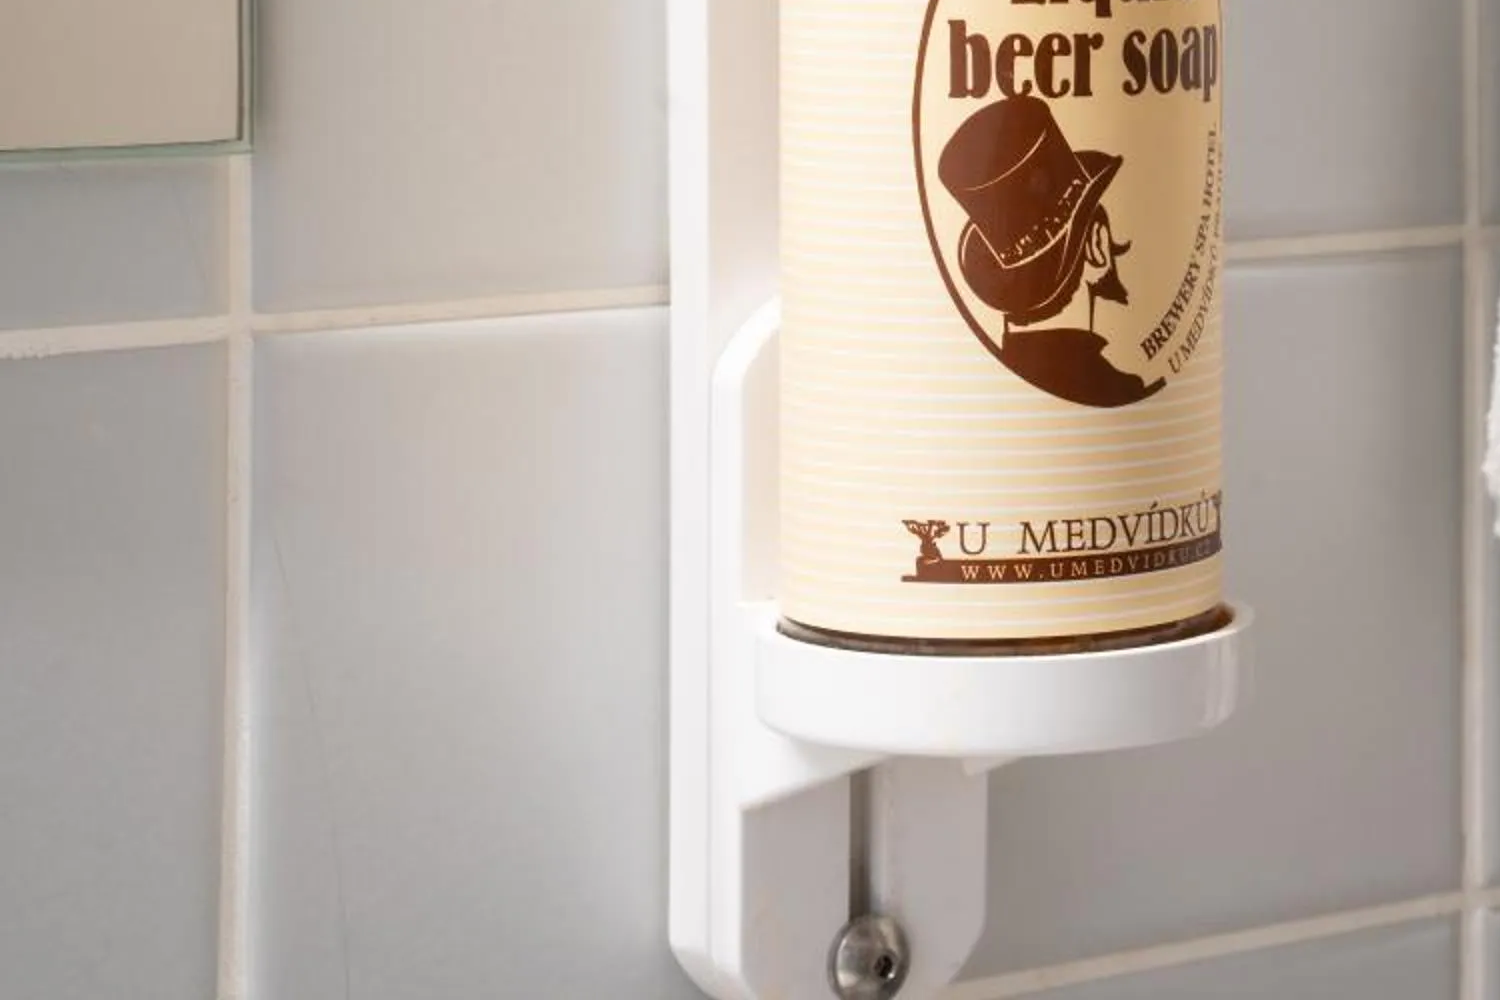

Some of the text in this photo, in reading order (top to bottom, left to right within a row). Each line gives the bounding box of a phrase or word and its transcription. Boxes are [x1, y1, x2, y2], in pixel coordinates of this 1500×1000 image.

[948, 19, 1217, 102] beer soap
[1140, 261, 1200, 361] BREWERY
[1194, 214, 1211, 257] SPA
[957, 521, 991, 556] U
